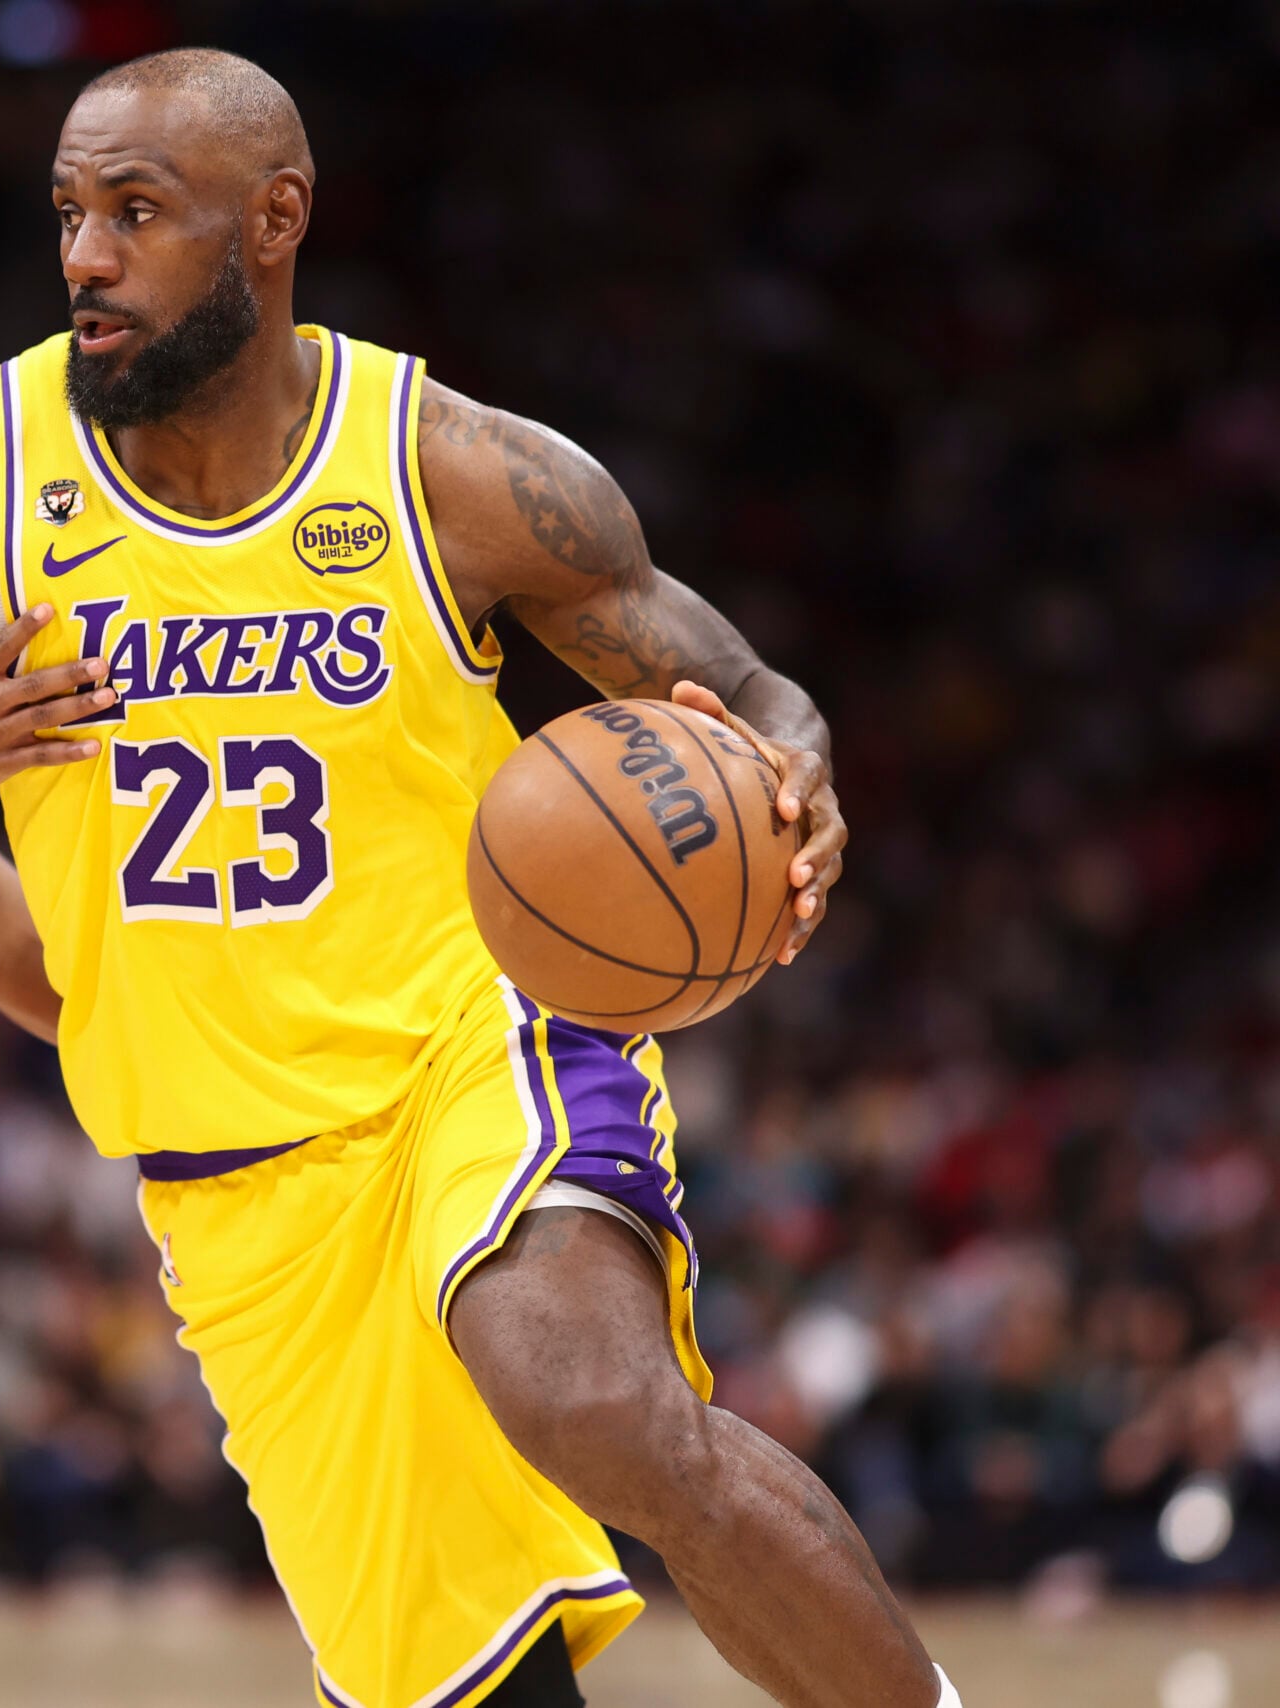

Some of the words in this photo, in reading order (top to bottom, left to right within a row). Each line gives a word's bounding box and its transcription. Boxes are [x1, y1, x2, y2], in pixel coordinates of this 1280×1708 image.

[301, 521, 383, 551] bibigo
[318, 546, 353, 560] 비비고
[59, 595, 394, 728] LAKERS
[110, 734, 335, 929] 23
[580, 702, 718, 868] Wilson
